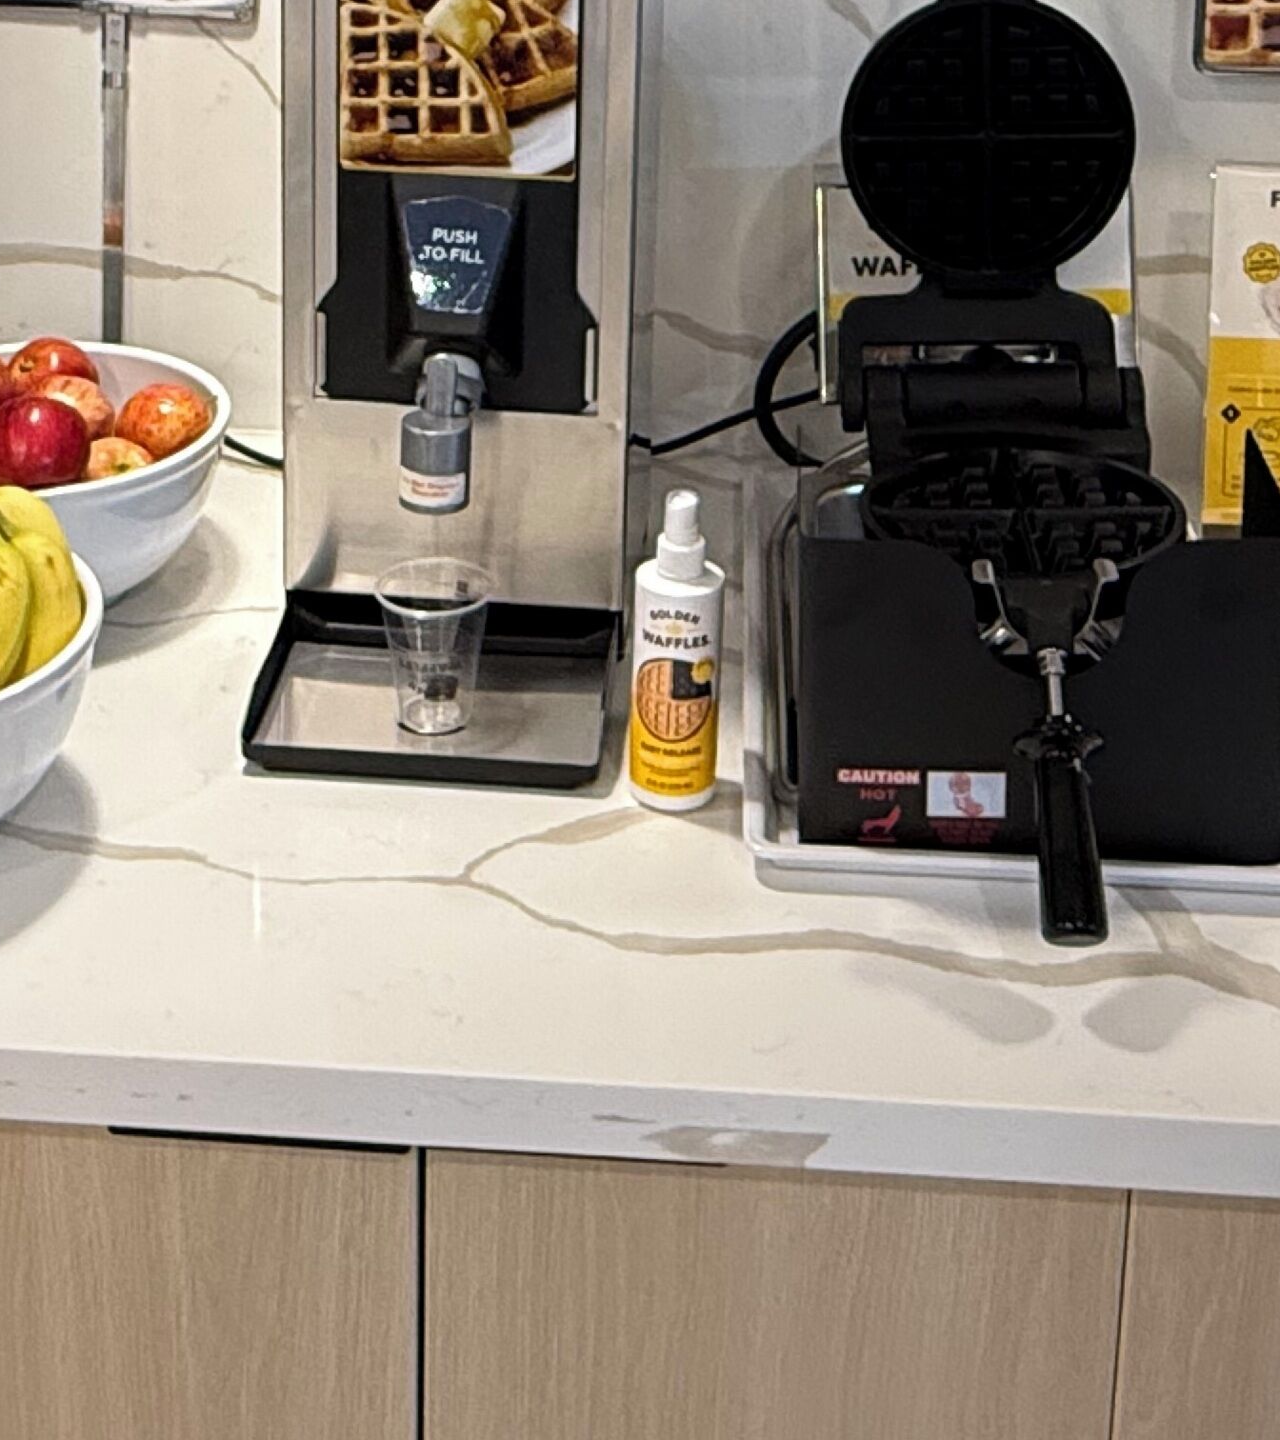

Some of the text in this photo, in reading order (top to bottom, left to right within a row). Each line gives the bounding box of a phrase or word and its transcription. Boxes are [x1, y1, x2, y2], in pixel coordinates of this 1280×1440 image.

[431, 226, 478, 245] PUSH
[449, 247, 485, 265] FILL
[650, 609, 700, 624] GOLDEN
[838, 768, 920, 784] CAUTION
[860, 788, 896, 801] HOT
